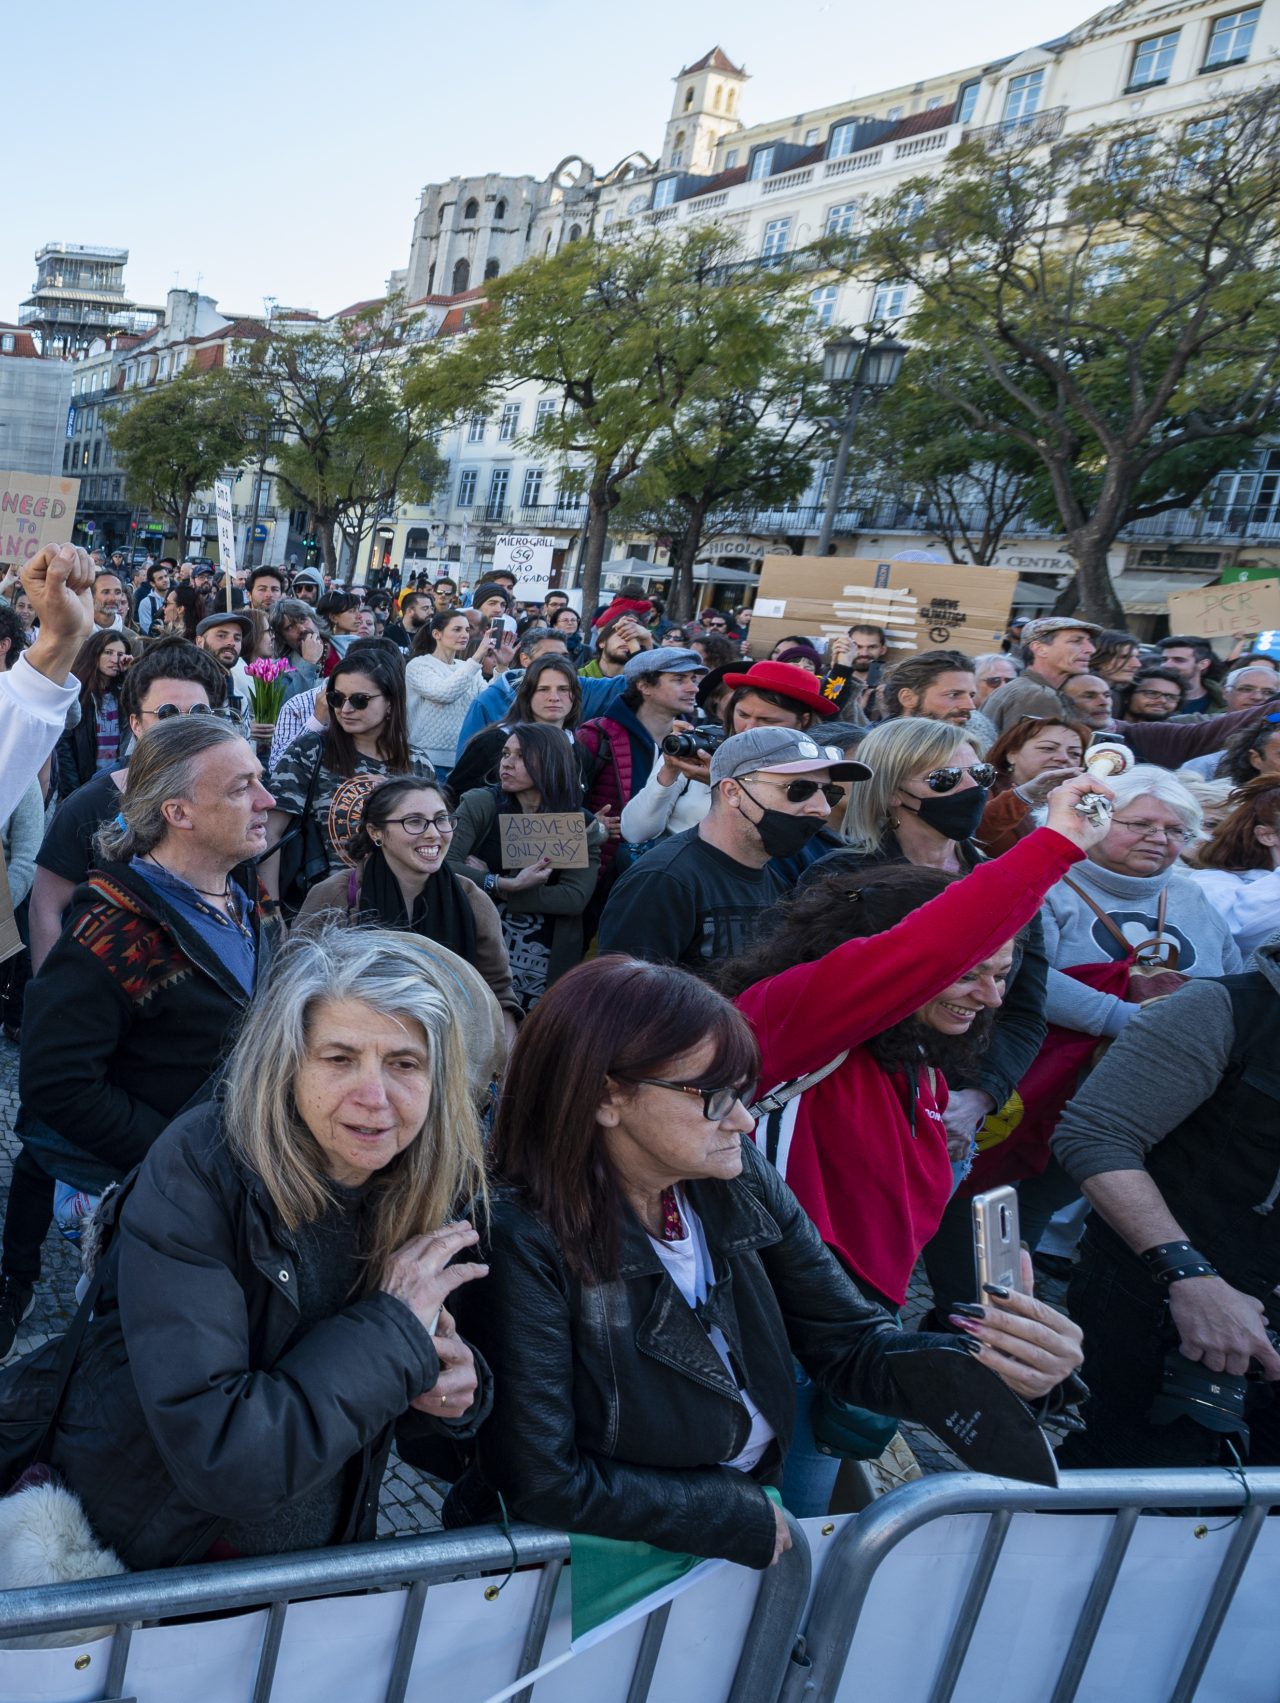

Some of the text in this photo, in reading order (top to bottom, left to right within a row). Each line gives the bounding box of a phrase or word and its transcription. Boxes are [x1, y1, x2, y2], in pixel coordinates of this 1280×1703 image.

[2, 491, 66, 518] NEED
[17, 517, 37, 534] TO
[1204, 593, 1253, 612] PCR
[1204, 615, 1262, 633] LIES
[505, 816, 584, 836] ABOVE US
[506, 839, 580, 861] ONLY SKY
